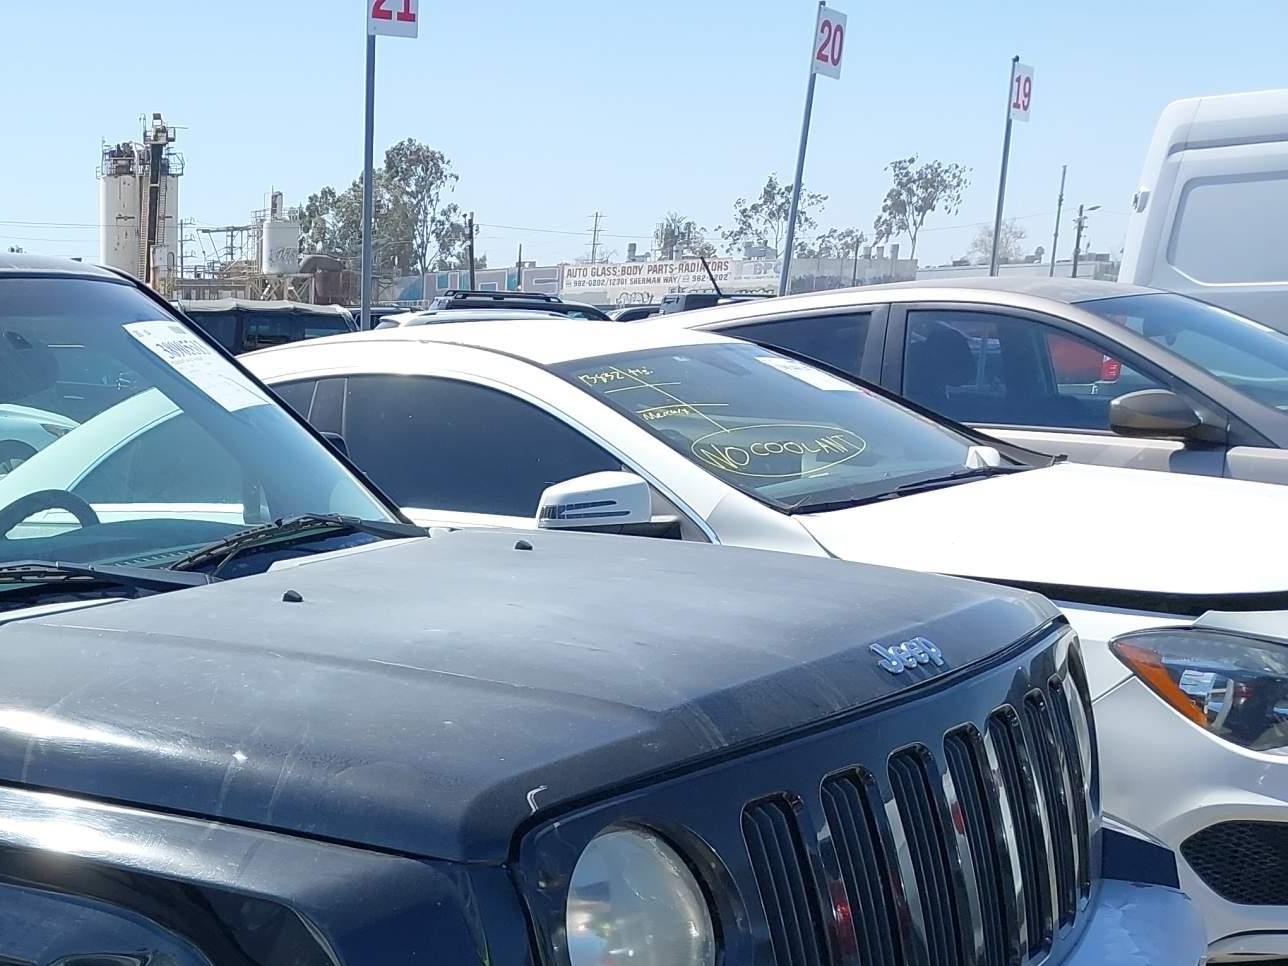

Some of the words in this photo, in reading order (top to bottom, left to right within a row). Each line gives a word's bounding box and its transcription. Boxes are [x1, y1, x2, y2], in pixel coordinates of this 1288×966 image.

[816, 19, 844, 66] 20
[1012, 74, 1032, 111] 19
[566, 267, 588, 279] AUTO
[629, 277, 661, 285] SHERMAN
[699, 443, 750, 470] NO
[750, 434, 852, 456] COOLANT
[869, 636, 944, 674] Jeep
